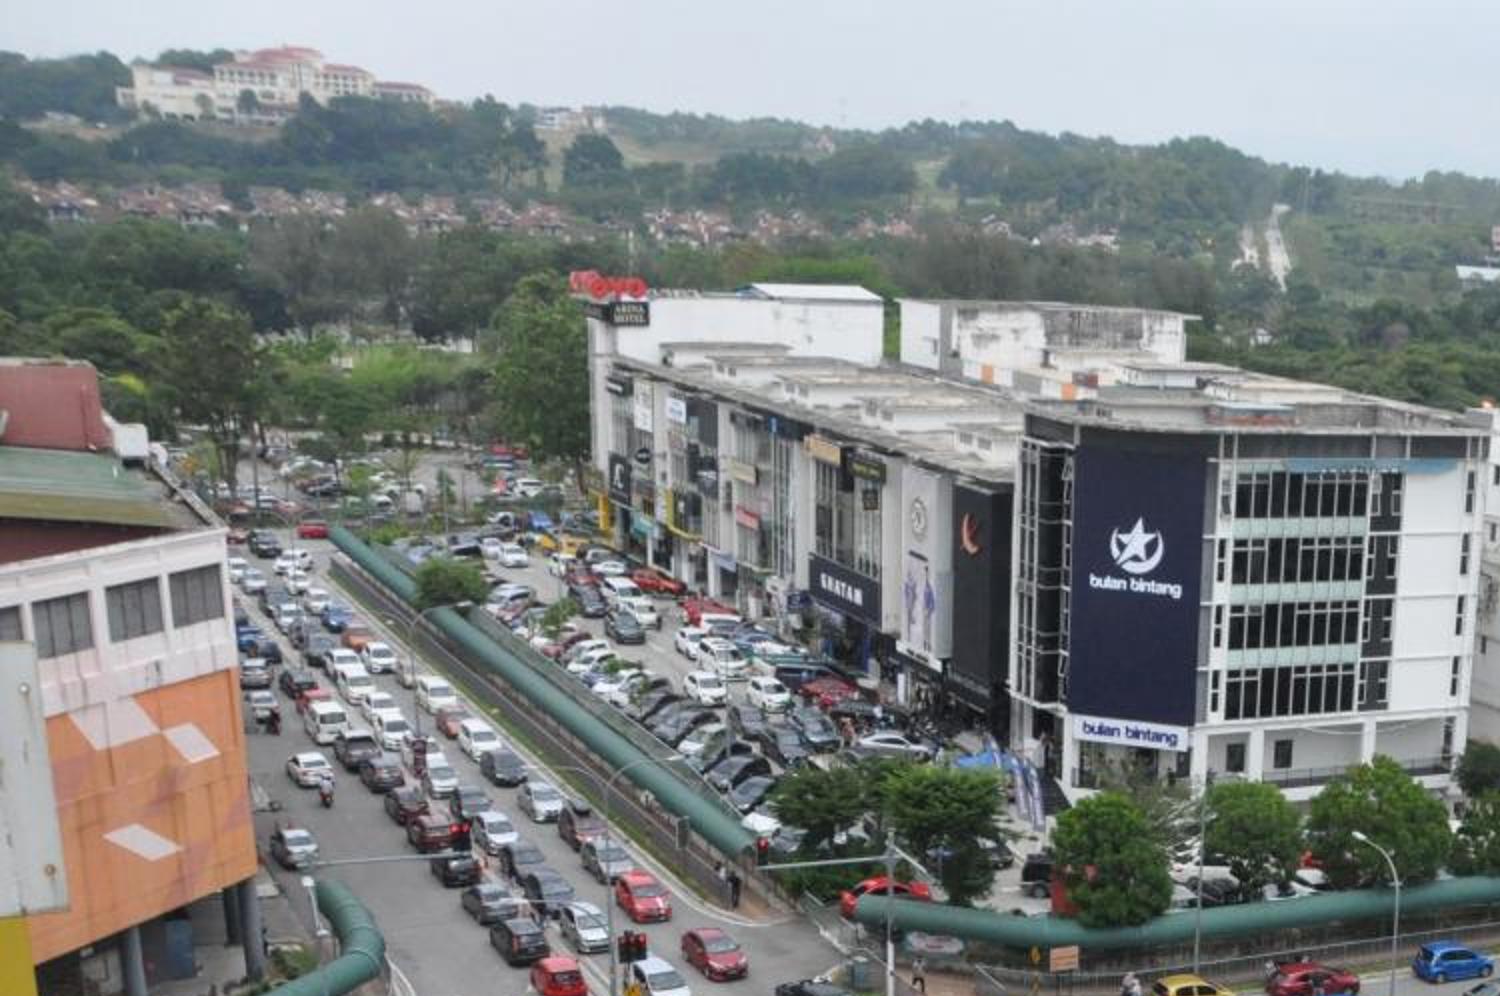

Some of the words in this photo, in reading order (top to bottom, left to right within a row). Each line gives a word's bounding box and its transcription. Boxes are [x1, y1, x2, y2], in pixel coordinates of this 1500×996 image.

[1089, 573, 1127, 592] bulan
[1130, 577, 1183, 599] bintang
[1083, 720, 1121, 739] bulan
[1125, 726, 1178, 747] bintang
